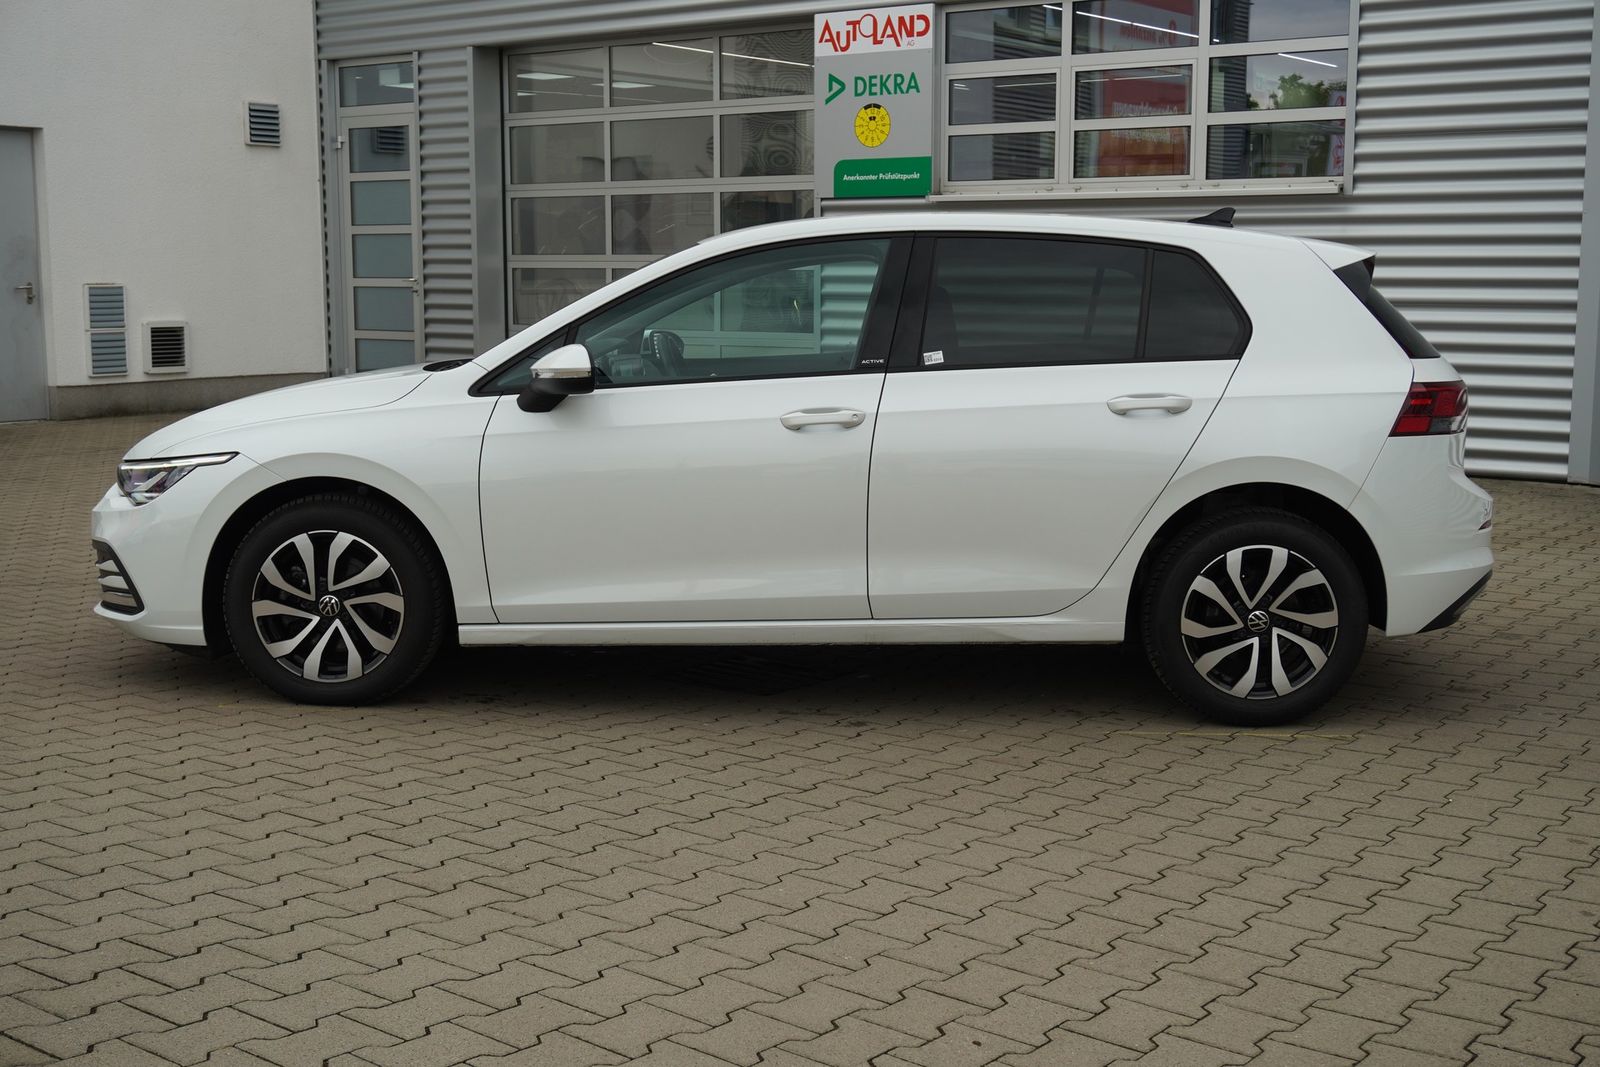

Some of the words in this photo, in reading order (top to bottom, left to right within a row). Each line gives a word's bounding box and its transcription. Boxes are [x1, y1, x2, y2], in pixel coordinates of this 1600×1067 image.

[818, 14, 931, 52] AUTOLAND
[854, 72, 920, 97] DEKRA
[843, 173, 878, 181] Anerkannter
[879, 171, 920, 181] Prüfstützpunkt
